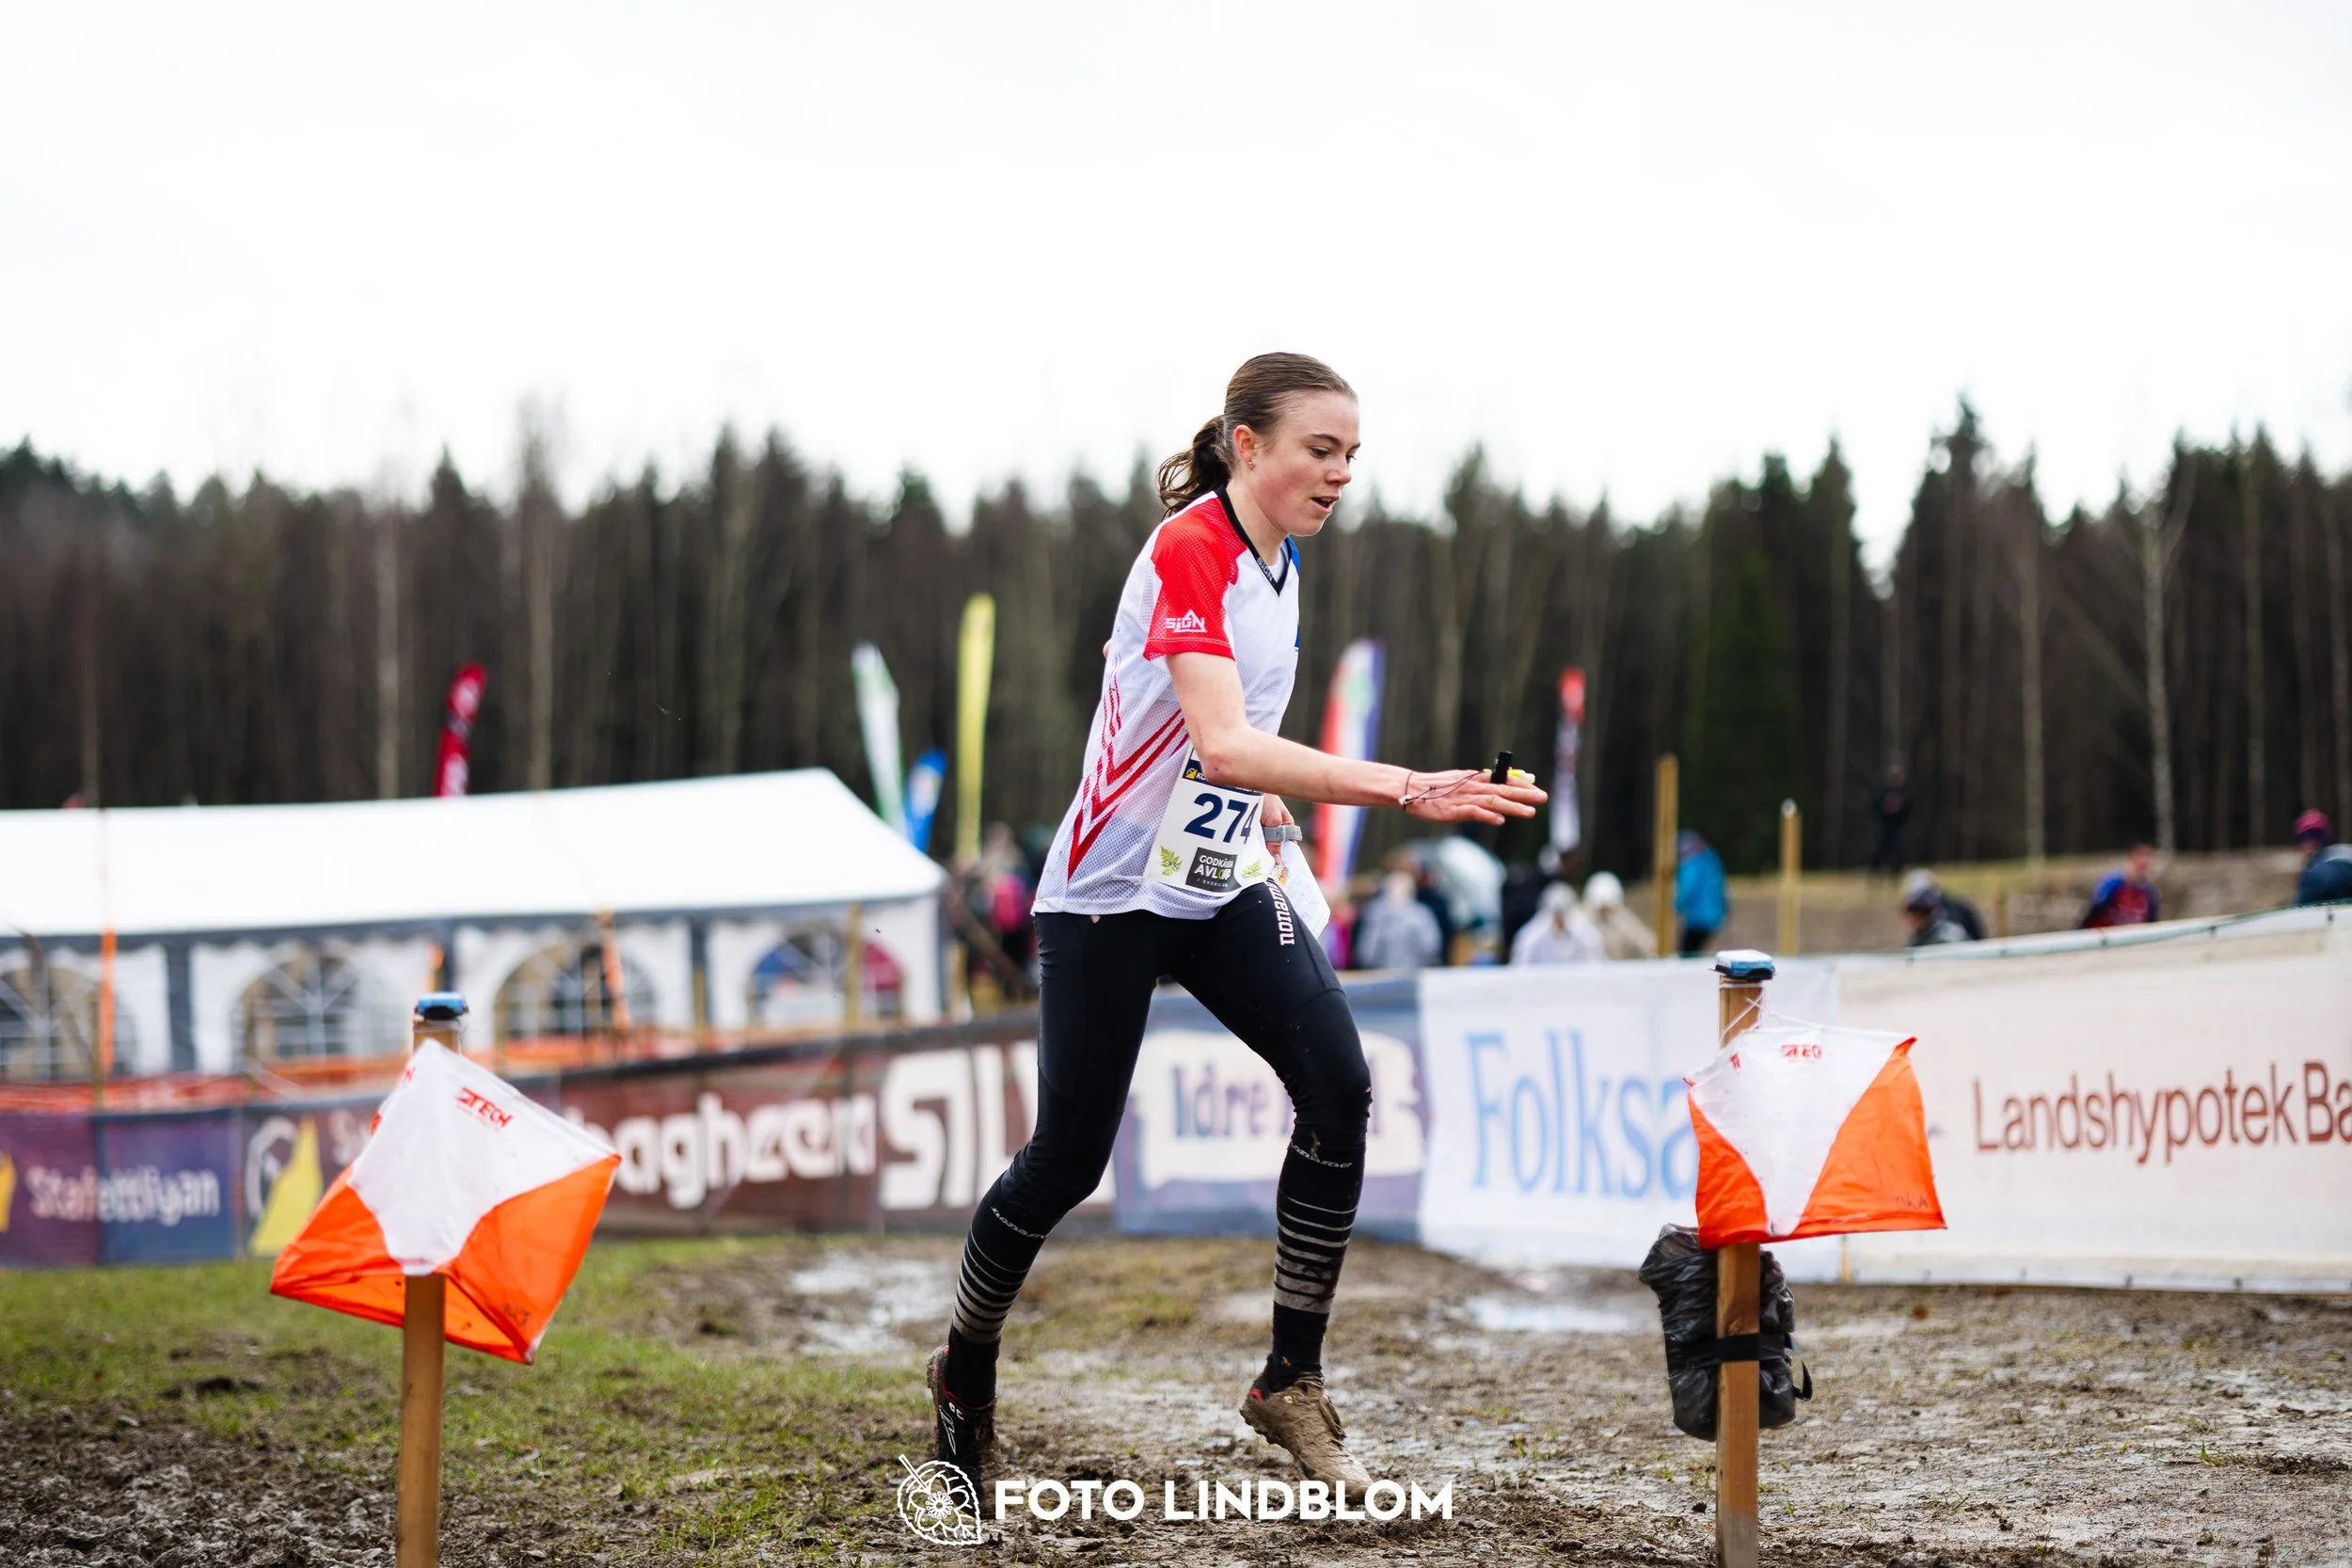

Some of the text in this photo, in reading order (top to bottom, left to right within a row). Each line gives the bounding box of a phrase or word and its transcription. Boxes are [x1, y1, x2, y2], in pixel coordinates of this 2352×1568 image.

[1184, 793, 1260, 844] 274
[1463, 1027, 1699, 1200] Folksa
[1971, 1063, 2297, 1164] Landshypotek
